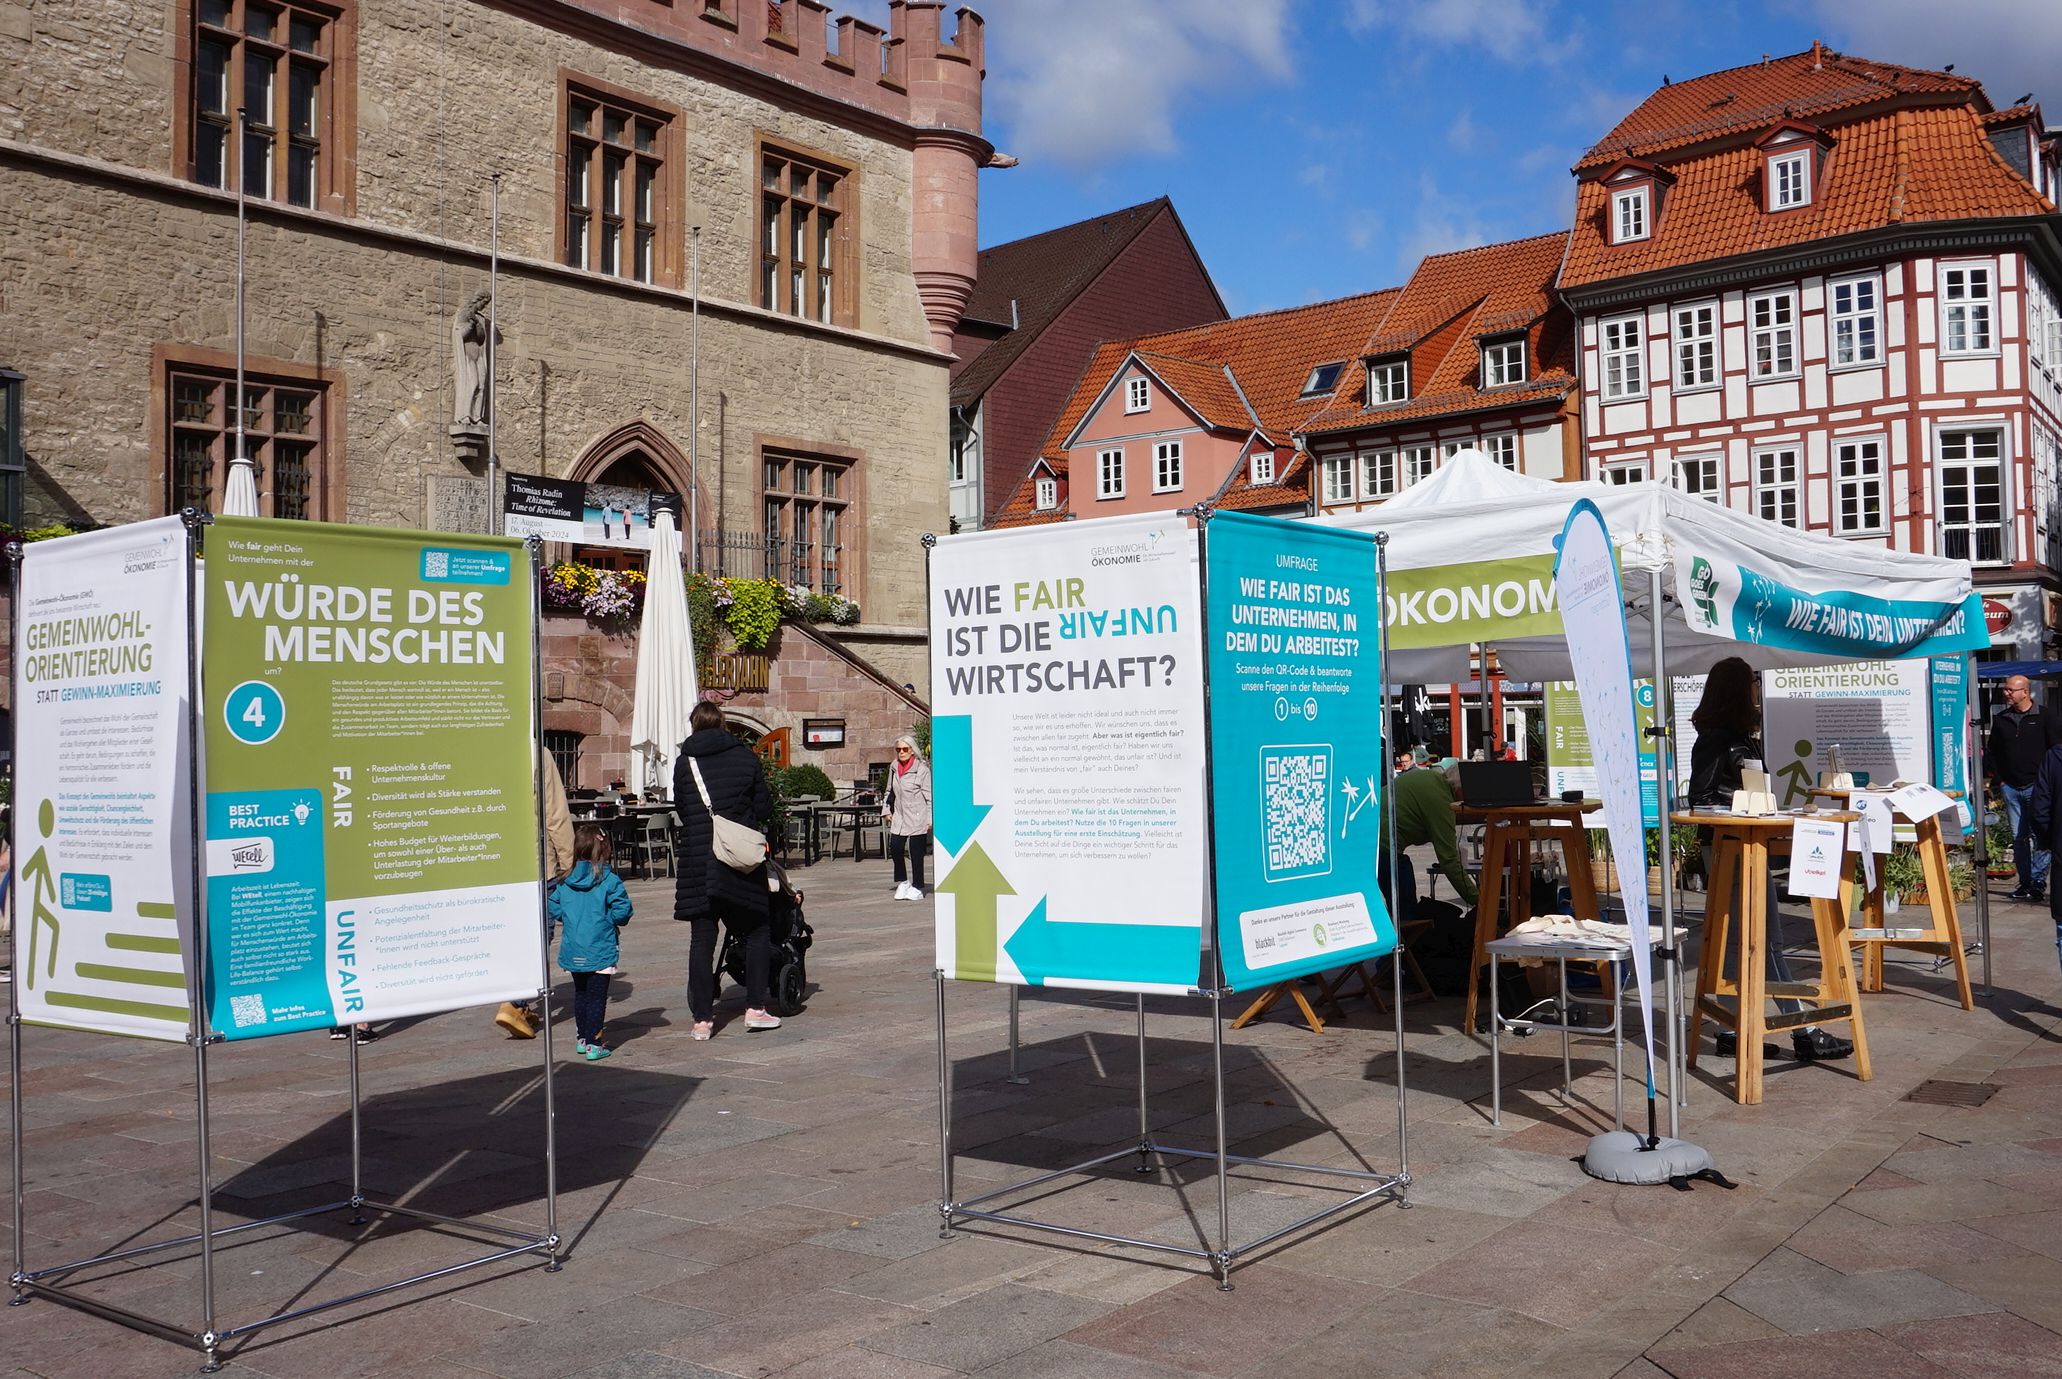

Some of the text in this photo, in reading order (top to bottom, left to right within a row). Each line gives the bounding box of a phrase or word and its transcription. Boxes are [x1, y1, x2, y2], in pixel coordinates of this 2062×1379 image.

[512, 484, 562, 498] Thomas Radin
[526, 496, 557, 506] Rhizome:
[512, 502, 527, 511] Time
[537, 506, 571, 517] Revelation
[521, 518, 543, 528] August
[228, 540, 303, 554] Wie fair geht Dein
[1090, 543, 1149, 556] GEMEINWOHL
[124, 561, 156, 574] ÖKONOMIE
[228, 554, 314, 567] Unternehmen mit der
[1092, 554, 1141, 567] ÖKONOMIE
[1276, 554, 1318, 572] UMFRAGE
[944, 577, 1086, 617] WIE FAIR
[1240, 577, 1350, 606] WIE FAIR IST DAS
[224, 573, 484, 626] WÜRDE DES
[1232, 604, 1356, 633] UNTERNEHMEN, IN
[1785, 598, 1820, 631] WIE
[1818, 605, 1848, 637] FAIR
[1846, 610, 1864, 639] IST
[1865, 613, 1894, 643] DEIN
[27, 610, 151, 650] GEMEINWOHL-
[947, 604, 1177, 656] IST DIE UNFAIR
[265, 625, 504, 664] MENSCHEN
[1226, 632, 1359, 656] DEM DU ARBEITEST?
[26, 643, 152, 682] ORIENTIERUNG
[1236, 663, 1352, 677] Scanne den QR-Code & beantworte
[265, 667, 282, 676] um?
[946, 655, 1176, 696] WIRTSCHAFT?
[1674, 680, 1704, 692] ERSCHÖPF
[1775, 673, 1899, 688] ORIENTIERUNG
[37, 680, 161, 704] STATT GEWINN-MAXIMIERUNG
[1242, 682, 1349, 695] unsere Fragen in der Reihenfolge
[1643, 690, 1652, 702] 8
[1815, 689, 1911, 698] GEWINN-MAXIMIERUNG
[243, 696, 266, 727] 4
[1279, 703, 1315, 714] 1 bis 10
[1135, 730, 1167, 740] eigentlich
[1555, 726, 1564, 749] FAIR
[372, 764, 418, 773] Respektvolle
[372, 774, 446, 784] Unternehmenskultur
[333, 766, 352, 828] FAIR
[372, 792, 407, 801] Diversität
[408, 791, 425, 799] wird
[438, 790, 461, 798] Stärke
[463, 788, 501, 797] verstanden
[229, 804, 260, 816] BEST
[372, 810, 411, 820] Förderung
[428, 807, 470, 816] Gesundheit
[487, 804, 506, 812] durch
[230, 816, 290, 829] PRACTICE
[372, 820, 428, 831] Sportangebote
[374, 832, 502, 848] Hohes Budget für Weiterbildungen,
[388, 849, 414, 858] sowohl
[416, 847, 434, 855] einer
[436, 844, 456, 854] Über-
[470, 843, 486, 851] auch
[374, 860, 422, 870] Unterlastung
[424, 857, 436, 866] der
[374, 870, 423, 880] vorzubeugen
[374, 902, 444, 915] Gesundheitsschutz
[457, 895, 505, 907] bürokratische
[374, 913, 430, 926] Angelegenheit
[375, 923, 506, 944] Potenzialentfaltung der Mitarbeiter-
[403, 944, 418, 952] wird
[420, 940, 438, 949] nicht
[441, 936, 480, 947] unterstützt
[337, 910, 364, 1013] UNFAIR
[377, 951, 491, 972] Fehlende Feedback-Gespräche
[380, 968, 489, 990] Diversität wird nicht gefördert
[302, 1010, 326, 1018] Practice
